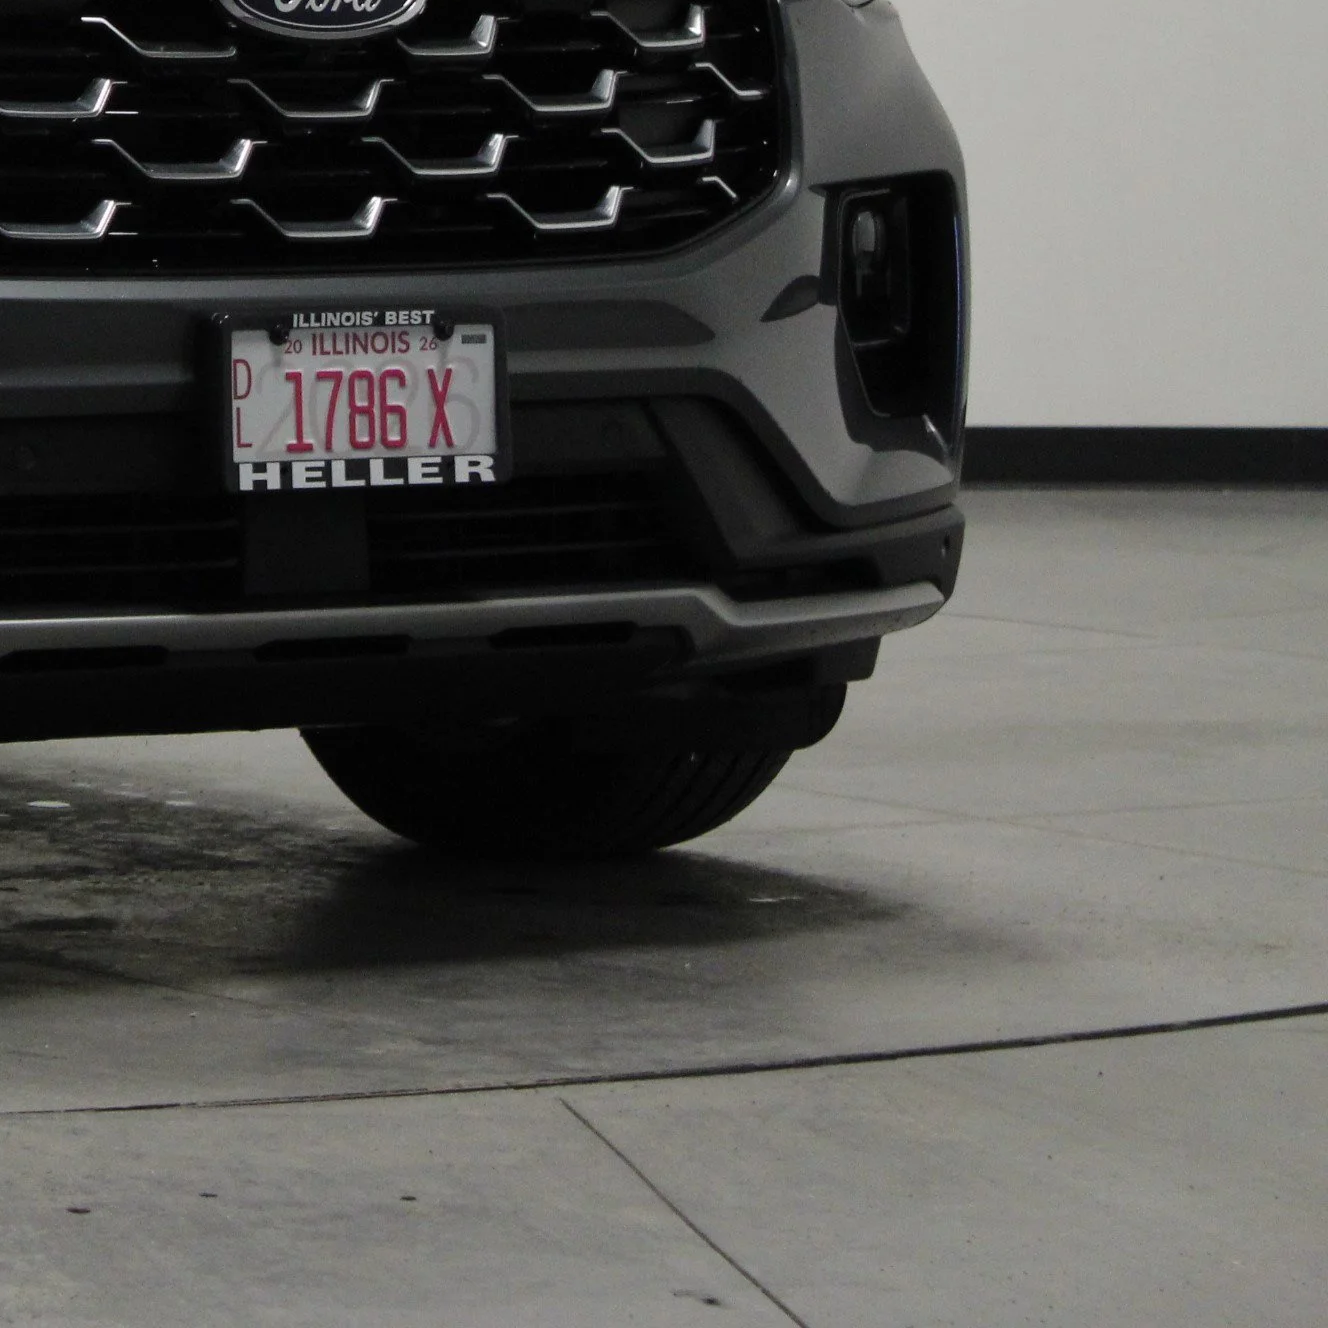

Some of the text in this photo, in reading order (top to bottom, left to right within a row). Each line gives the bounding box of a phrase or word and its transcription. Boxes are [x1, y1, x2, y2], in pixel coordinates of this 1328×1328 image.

[384, 309, 435, 325] BEST
[284, 330, 438, 356] 20 ILLINOIS 26
[285, 367, 454, 454] 1786 X
[239, 454, 496, 491] HELLER
